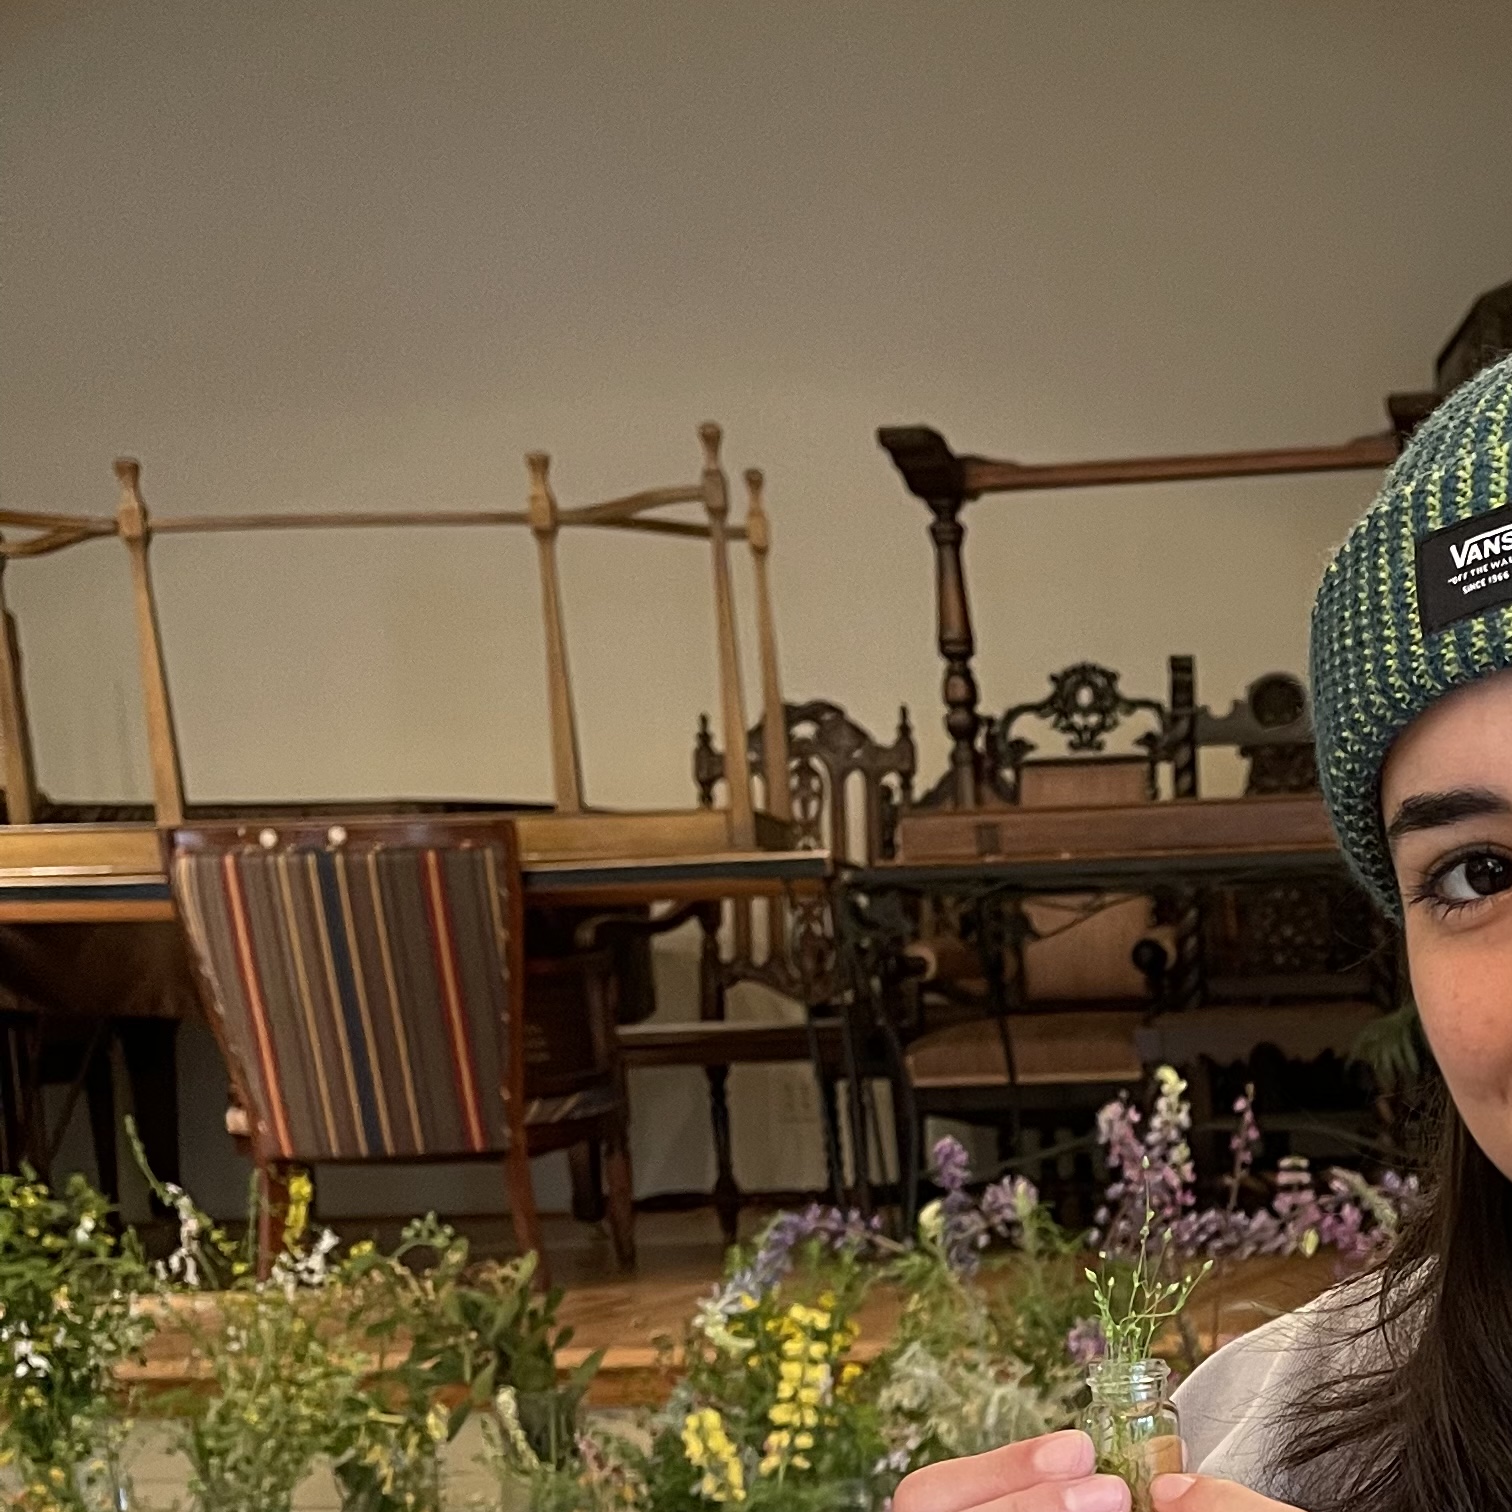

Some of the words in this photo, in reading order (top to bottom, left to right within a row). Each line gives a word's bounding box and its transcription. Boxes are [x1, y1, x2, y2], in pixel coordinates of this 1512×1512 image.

[1470, 564, 1489, 577] THE
[1462, 577, 1487, 595] SINCE
[1488, 570, 1510, 585] 1966
